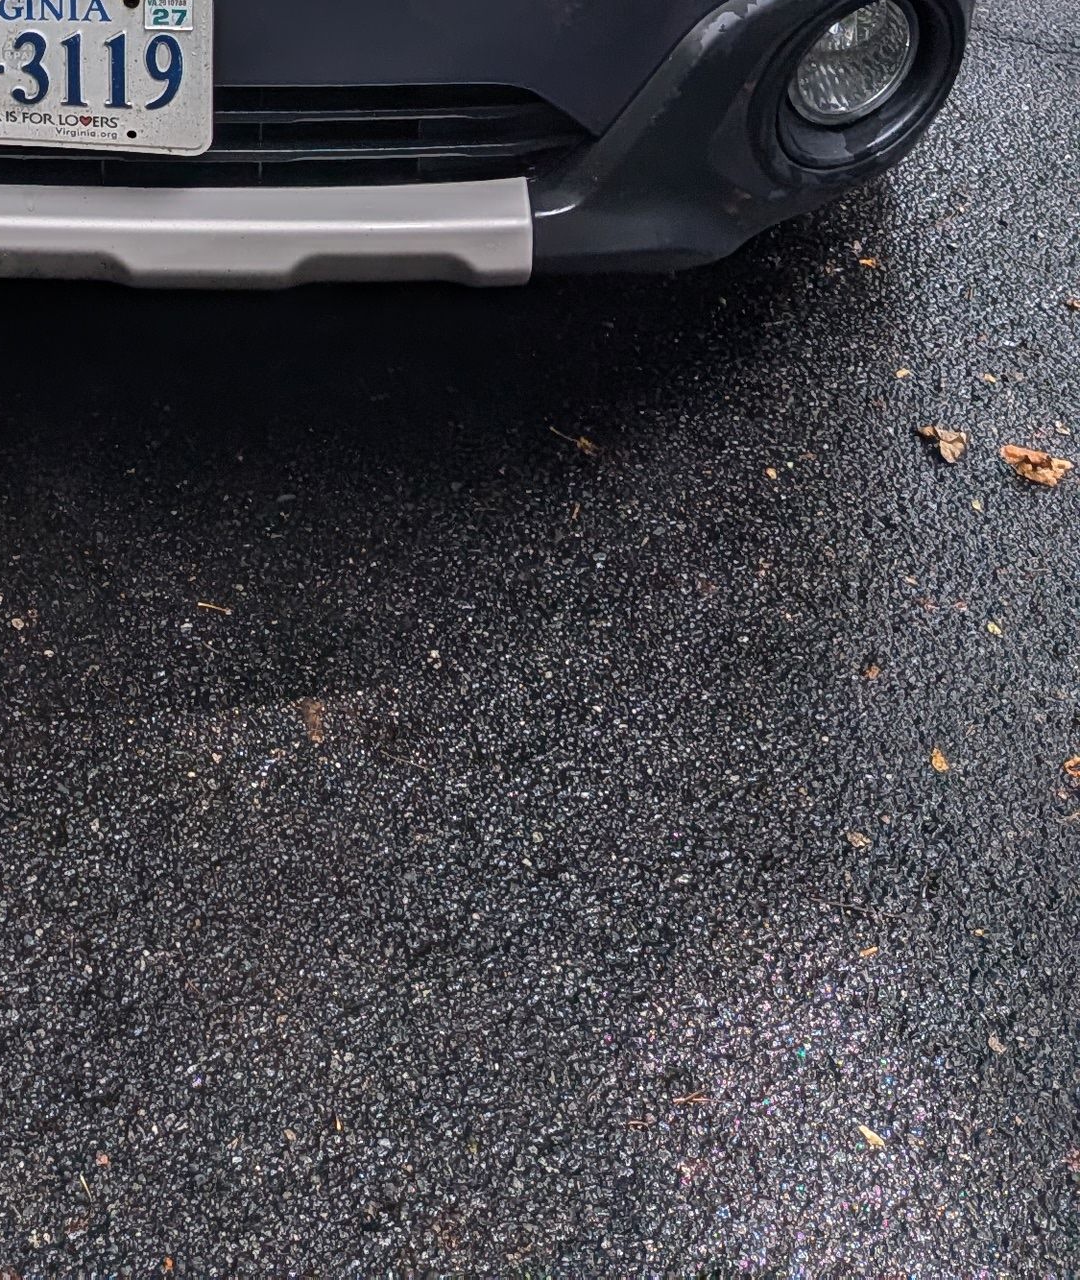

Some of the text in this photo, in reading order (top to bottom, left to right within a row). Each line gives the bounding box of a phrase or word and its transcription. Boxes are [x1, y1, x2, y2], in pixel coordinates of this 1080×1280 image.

[152, 9, 187, 25] 27
[5, 110, 17, 122] IS
[22, 112, 57, 125] FOR
[56, 127, 118, 139] Virginia.org
